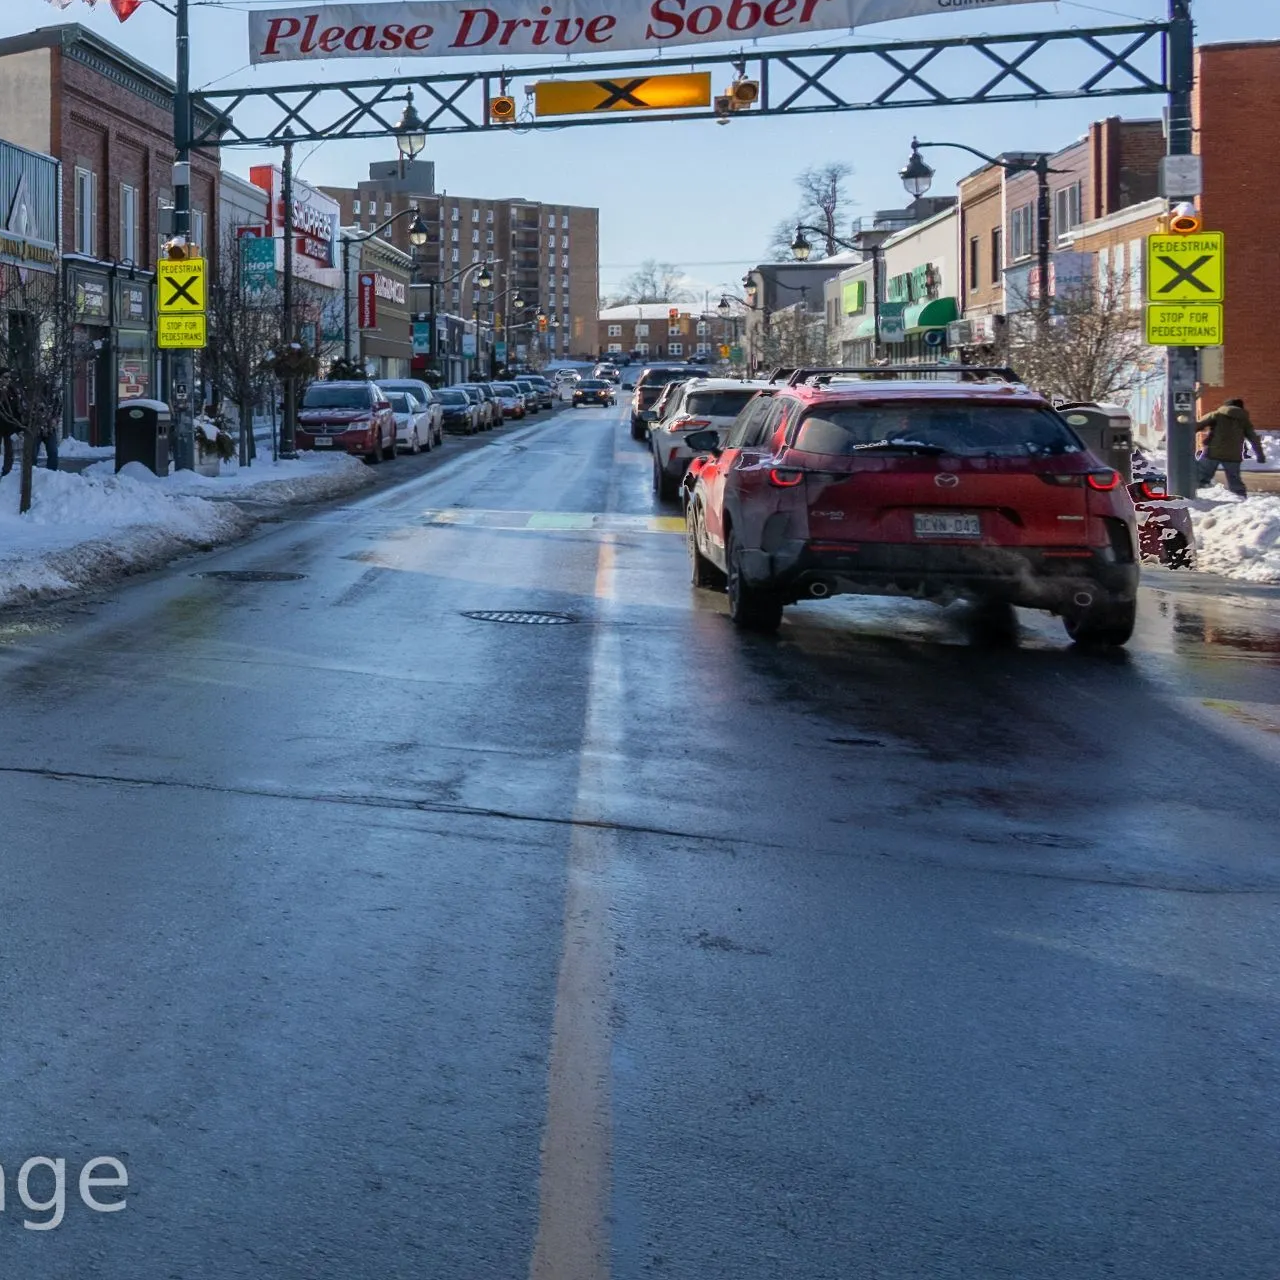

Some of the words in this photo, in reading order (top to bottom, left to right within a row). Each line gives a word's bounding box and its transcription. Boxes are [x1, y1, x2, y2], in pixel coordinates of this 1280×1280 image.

[260, 14, 434, 55] Please
[447, 6, 617, 48] Drive
[291, 199, 331, 242] SHOPPERS
[1152, 241, 1218, 252] PEDESTRIAN
[161, 264, 202, 274] PEDESTRIAN
[1159, 312, 1184, 323] STOP
[1190, 312, 1208, 323] FOR
[166, 321, 182, 330] STOP
[184, 321, 197, 330] FOR
[161, 332, 203, 341] PEDESTRIANS
[1151, 326, 1217, 337] PEDESTRIANS
